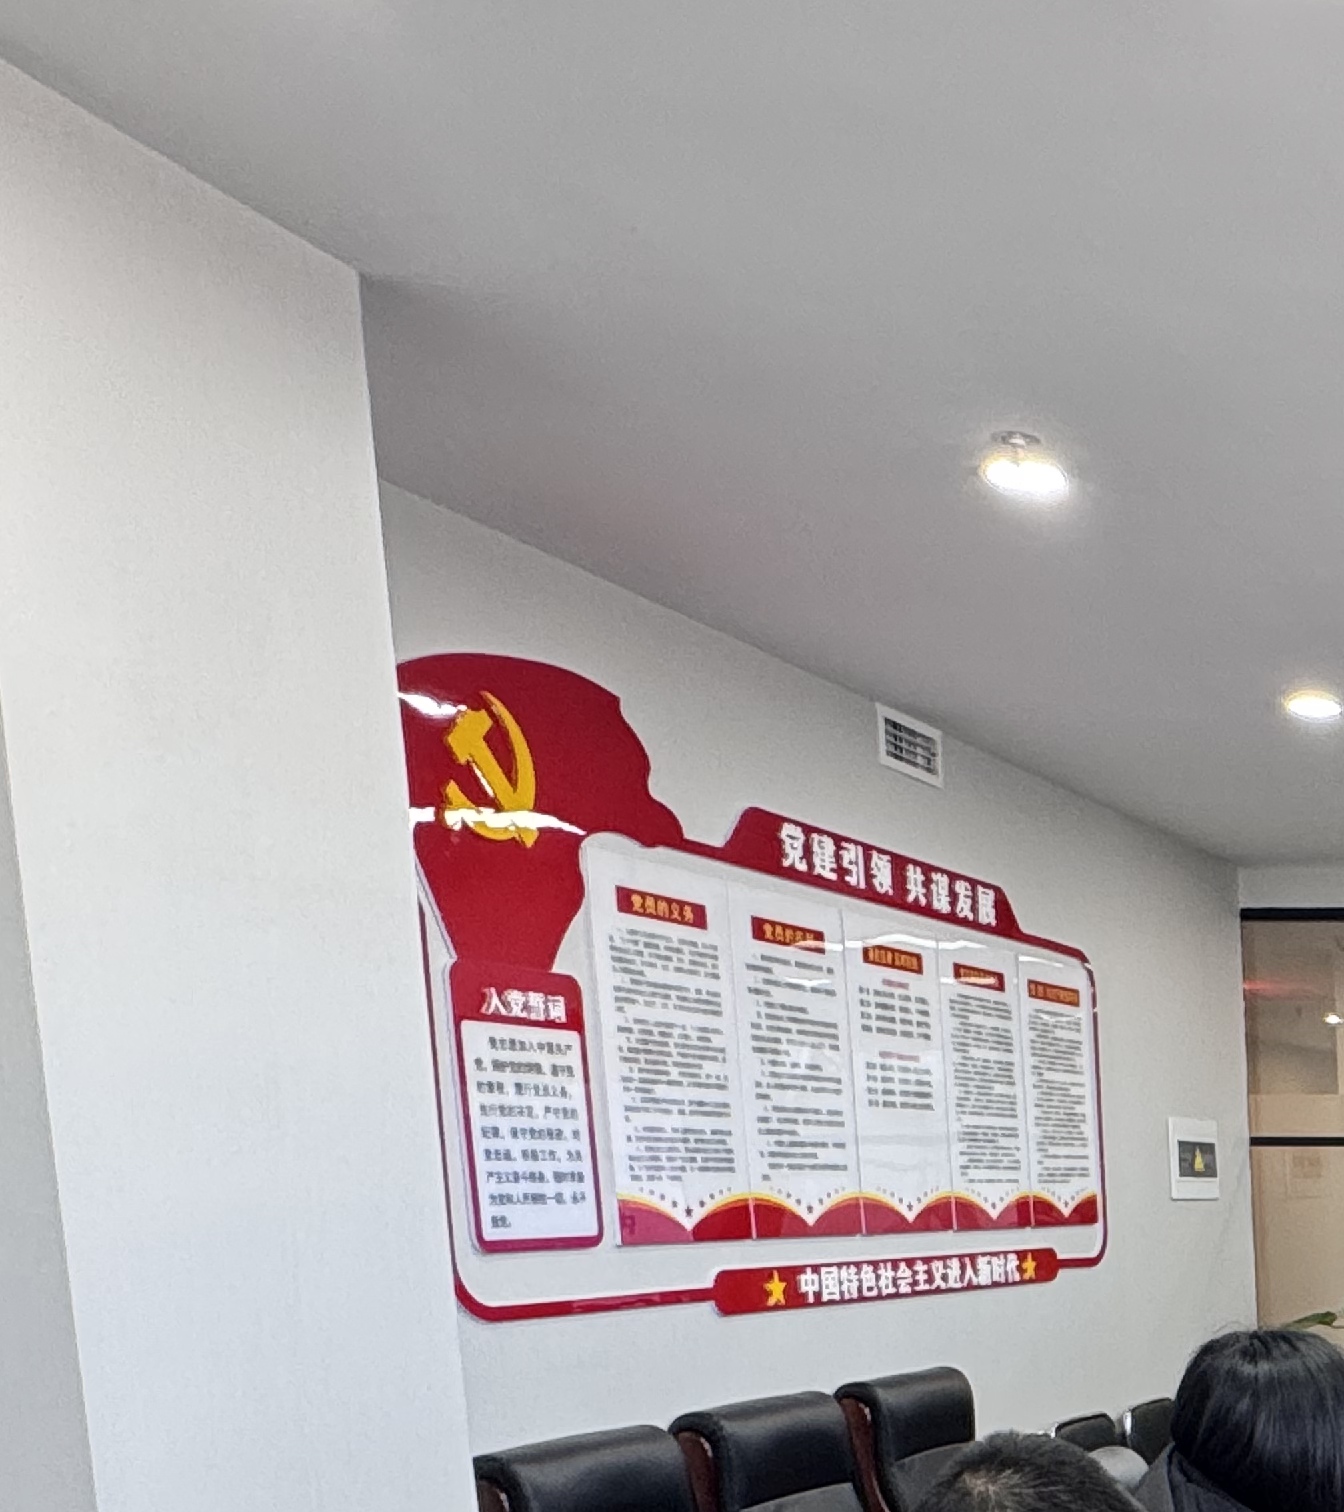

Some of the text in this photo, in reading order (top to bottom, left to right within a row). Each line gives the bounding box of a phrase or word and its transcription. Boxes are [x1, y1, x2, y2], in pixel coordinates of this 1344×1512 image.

[778, 822, 998, 926] 党建引领 共谋发展
[480, 987, 567, 1023] 入党誓词
[796, 1252, 1020, 1303] 中国特色社会主义进入新时代
